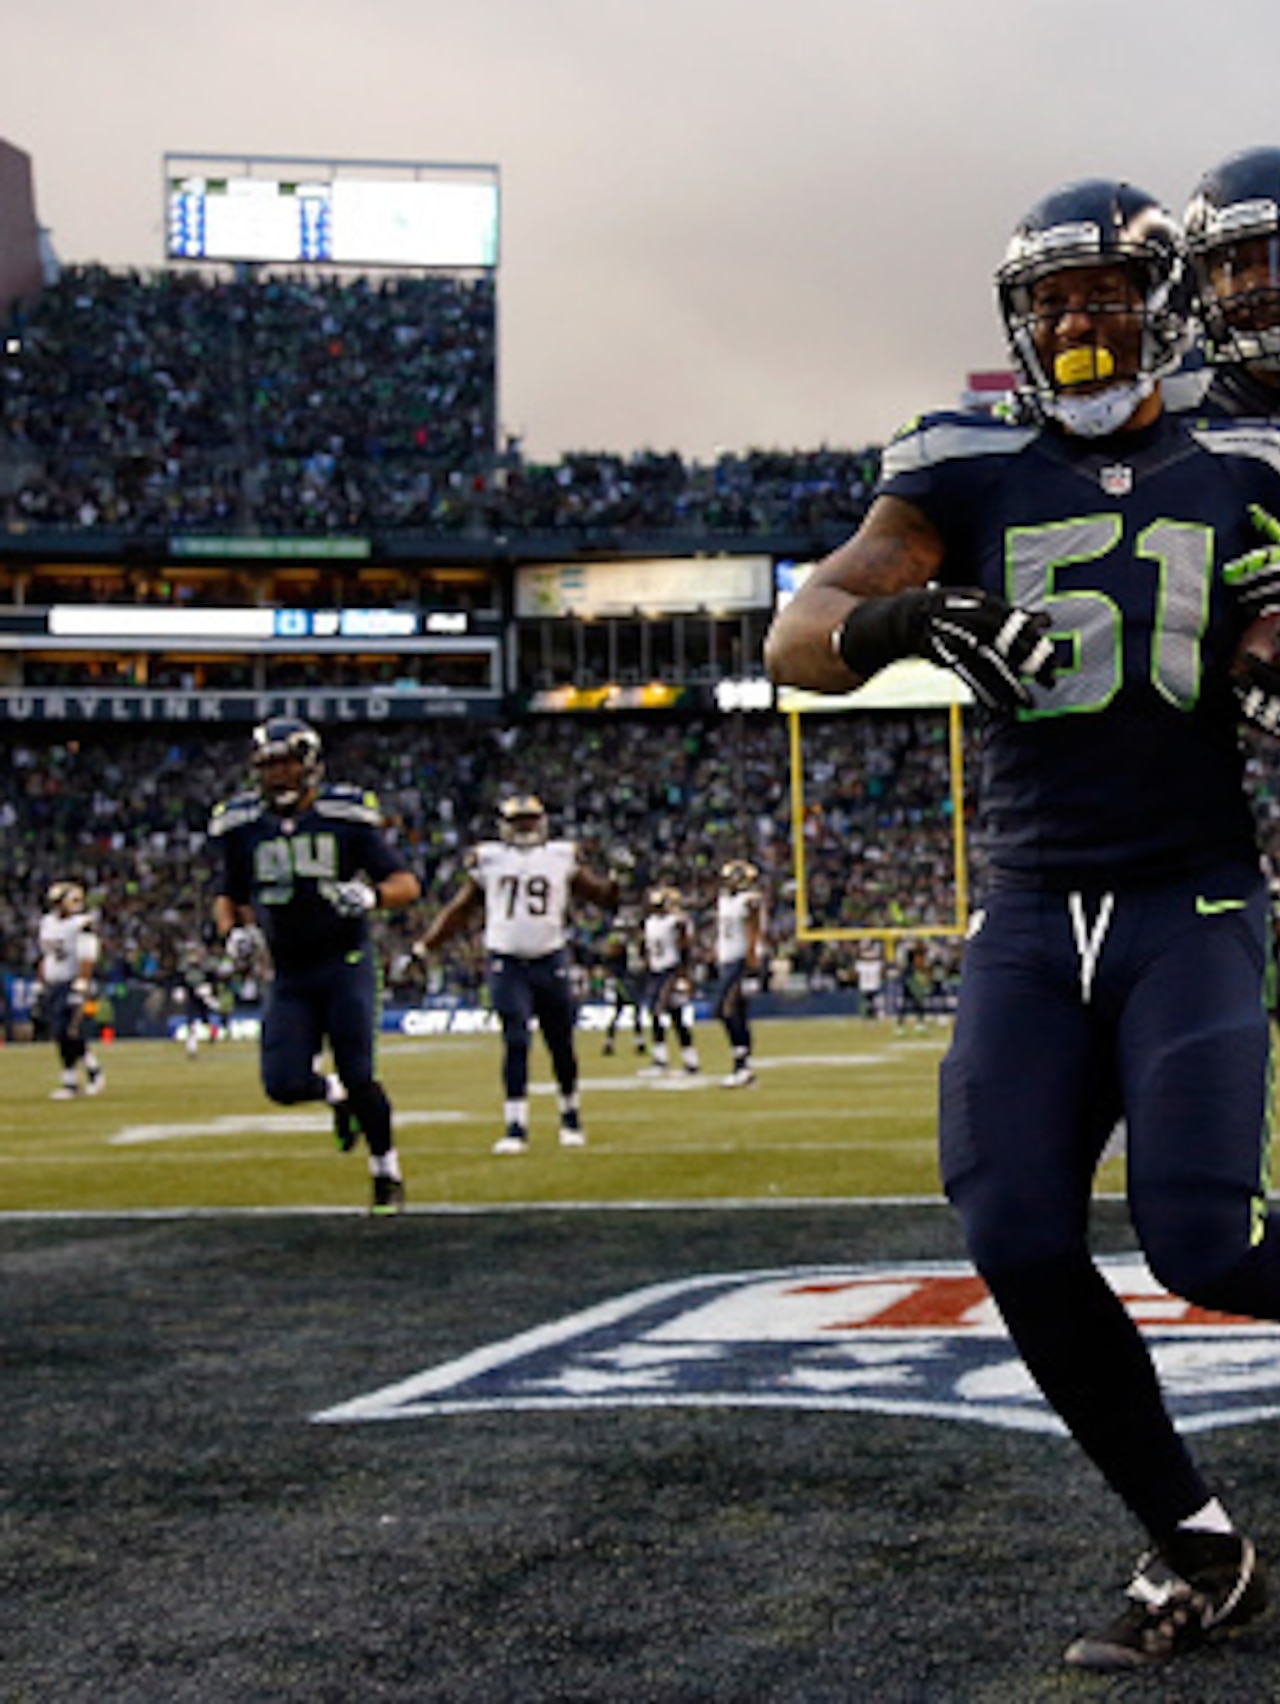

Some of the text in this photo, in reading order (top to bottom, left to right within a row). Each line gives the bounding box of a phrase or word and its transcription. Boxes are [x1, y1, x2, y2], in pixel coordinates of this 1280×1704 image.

[1004, 512, 1215, 722] 51
[255, 698, 391, 721] FIELD
[255, 832, 339, 904] 94
[499, 874, 549, 920] 79
